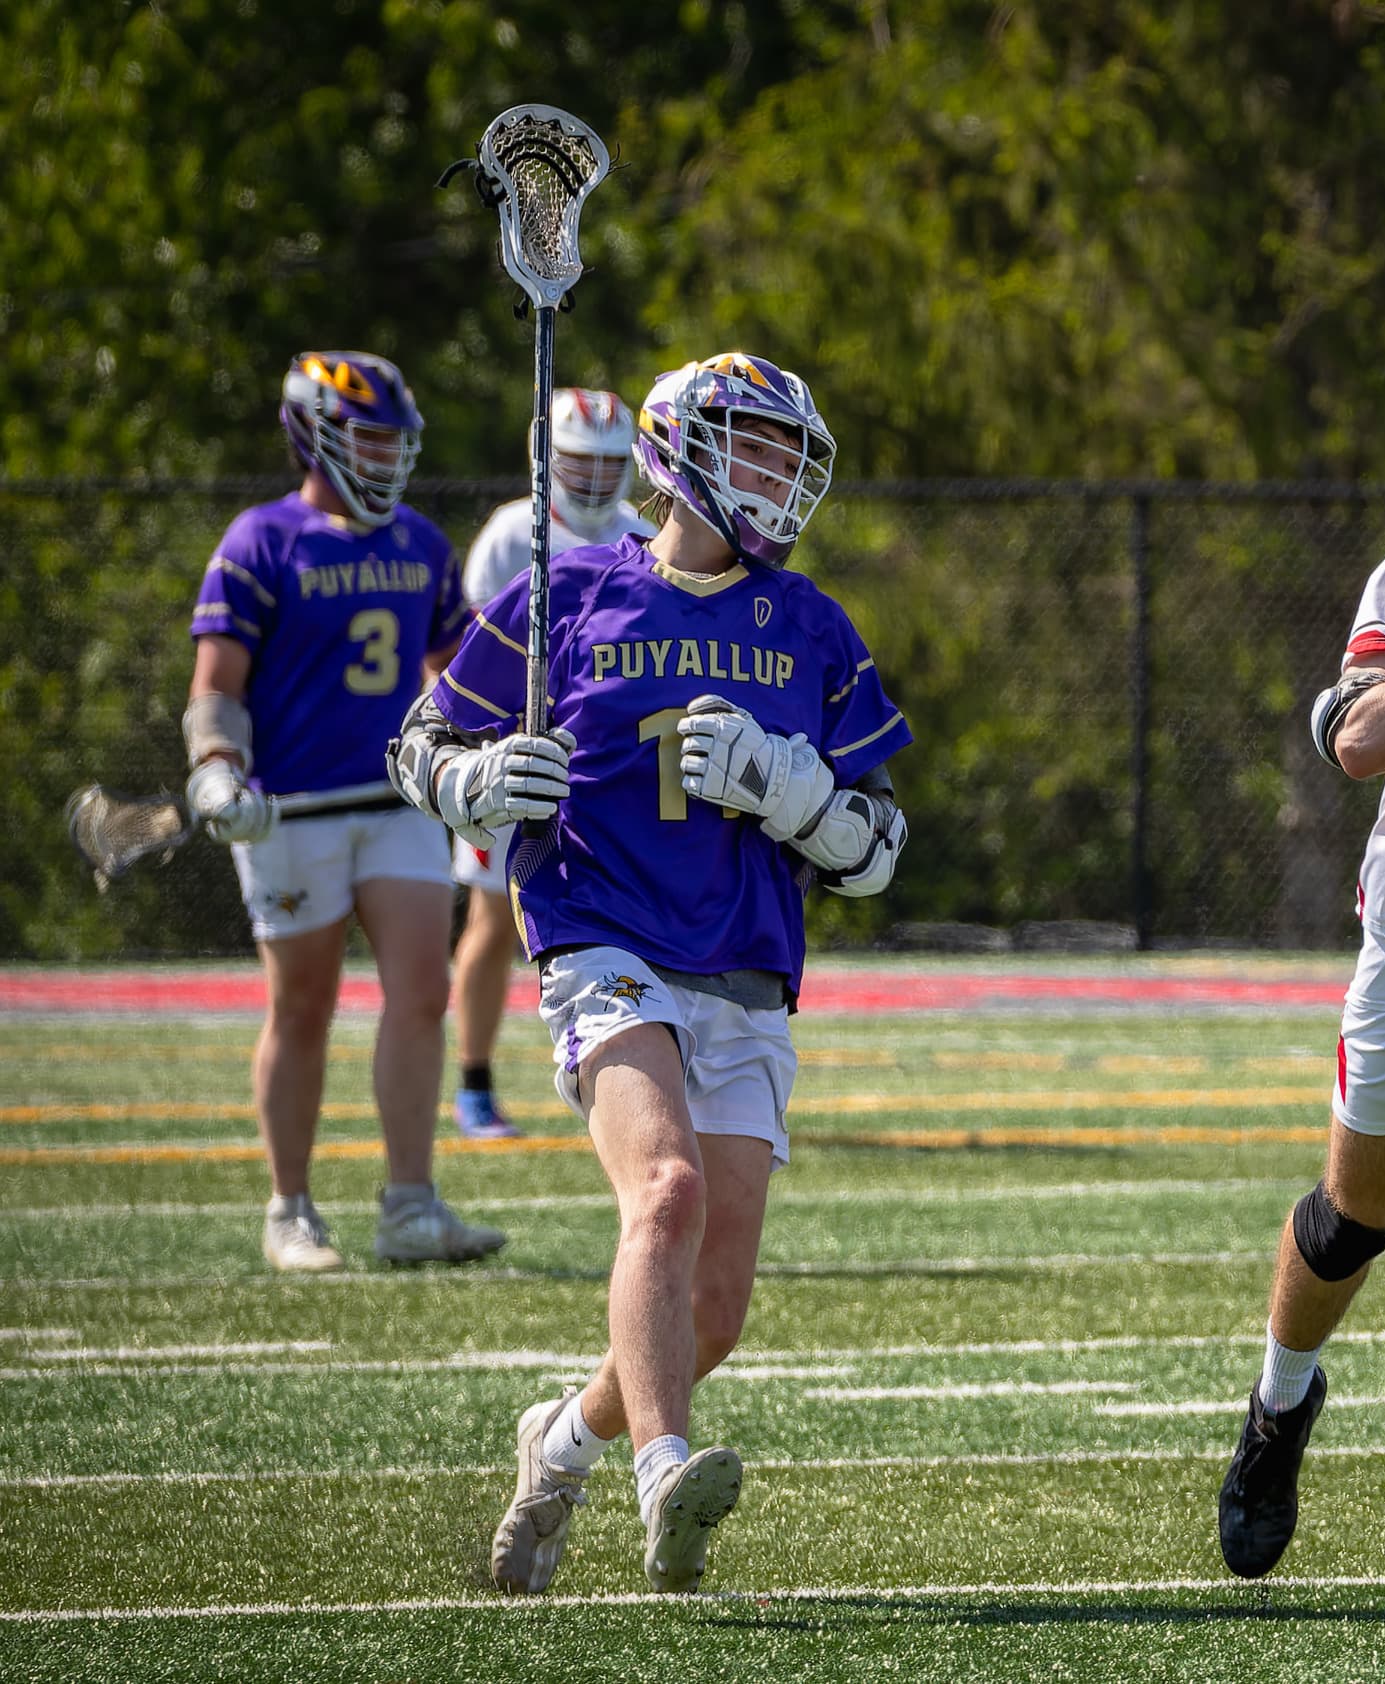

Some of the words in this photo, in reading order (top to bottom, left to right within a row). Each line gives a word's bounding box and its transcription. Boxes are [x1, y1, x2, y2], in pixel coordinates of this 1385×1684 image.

[299, 561, 432, 600] PUYALLUP
[343, 607, 399, 696] 3
[590, 638, 796, 690] PUYALLUP
